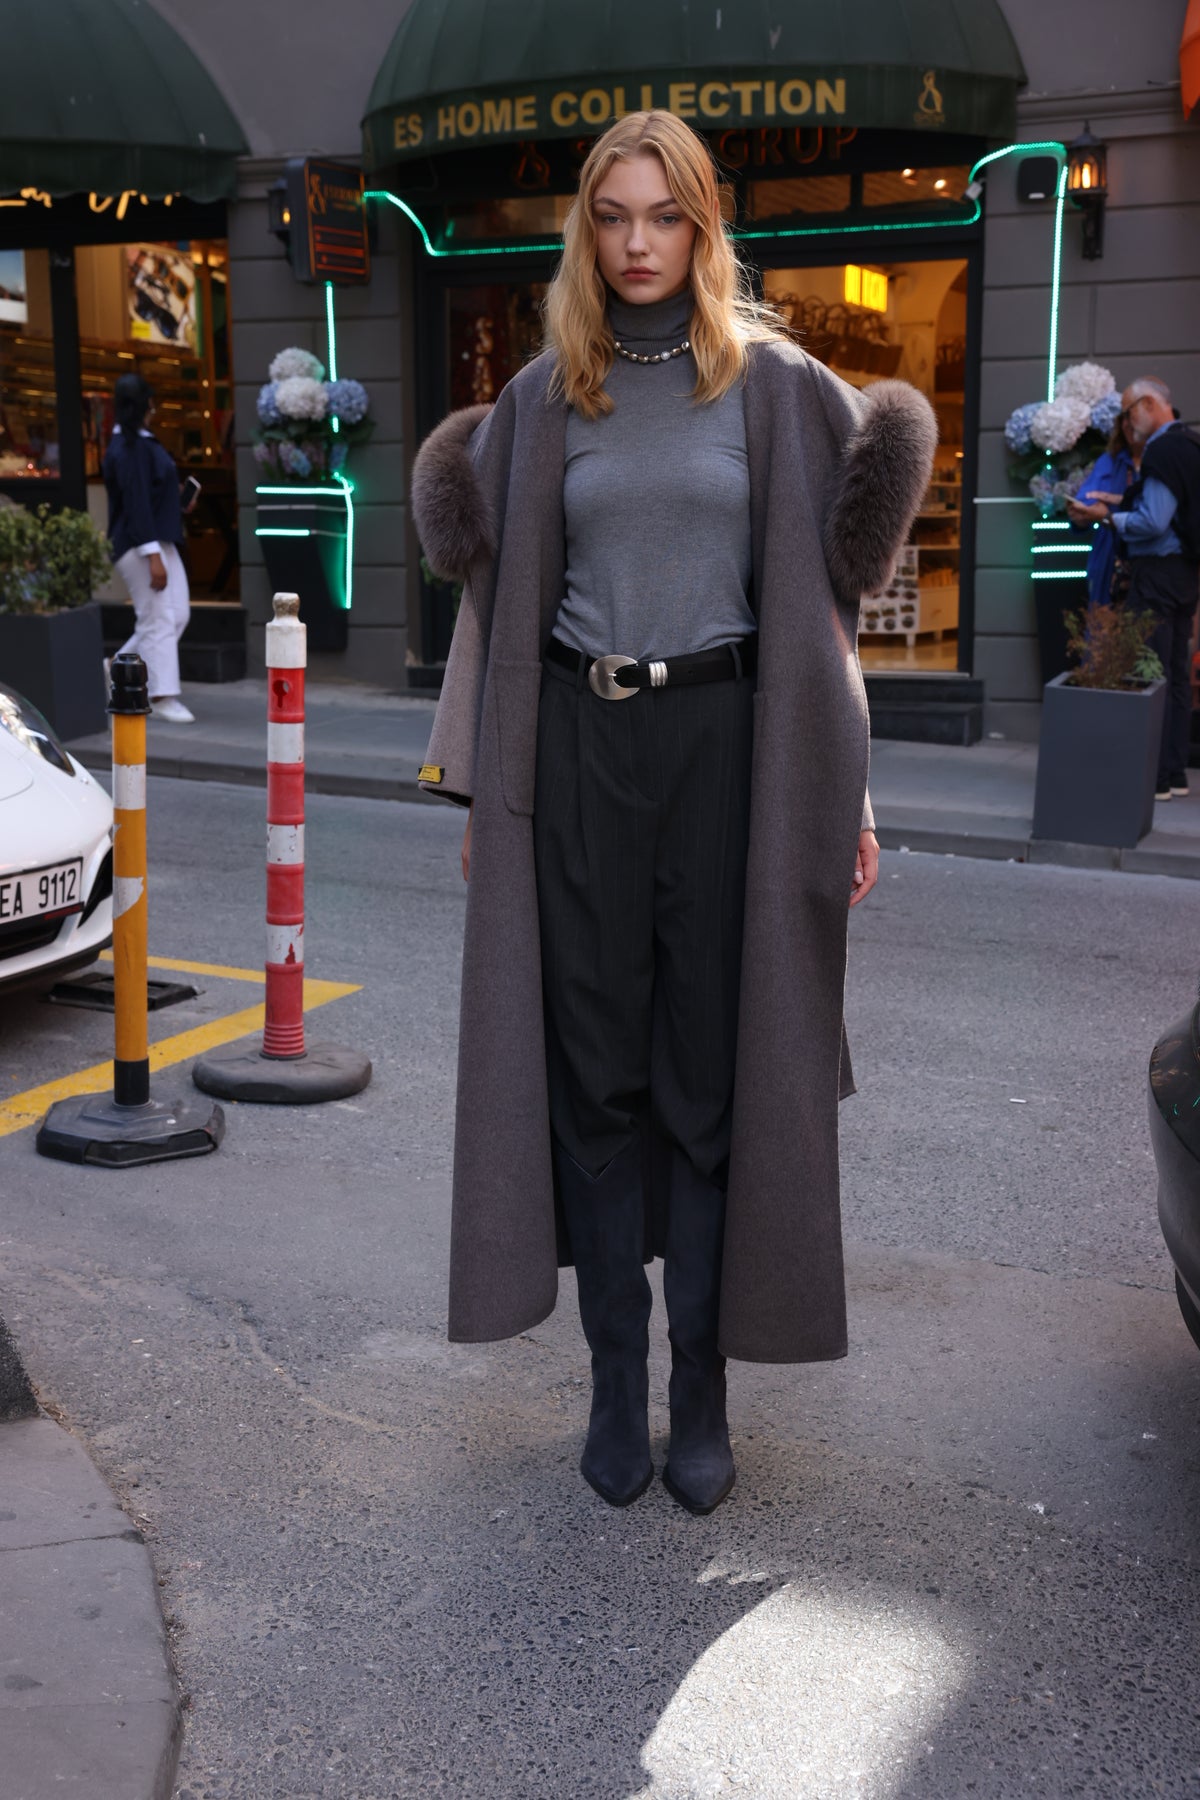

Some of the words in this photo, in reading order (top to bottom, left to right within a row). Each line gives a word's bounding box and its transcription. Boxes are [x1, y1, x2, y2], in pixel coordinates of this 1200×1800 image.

[393, 112, 424, 149] ES
[437, 95, 538, 141] HOME
[551, 79, 847, 127] COLLECTION
[0, 881, 23, 918] EA
[38, 868, 77, 909] 9112
